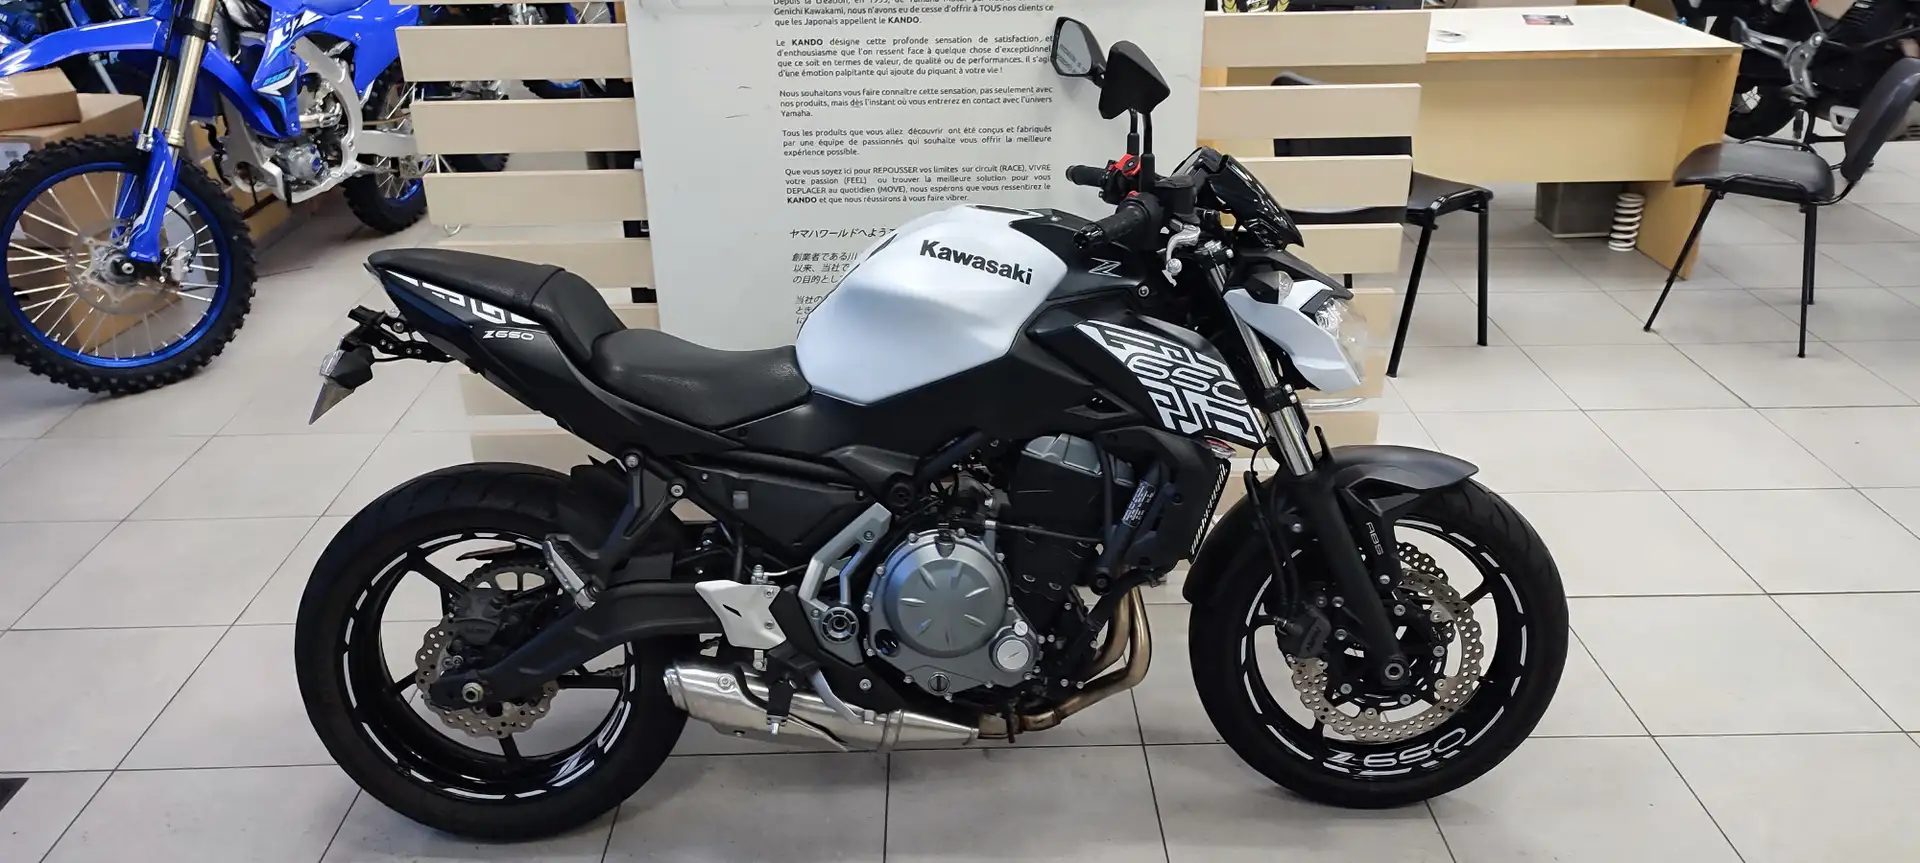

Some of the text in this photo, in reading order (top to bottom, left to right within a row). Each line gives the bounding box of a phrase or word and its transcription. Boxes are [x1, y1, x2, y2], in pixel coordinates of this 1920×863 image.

[773, 7, 803, 15] Genichi
[868, 6, 897, 14] n'avons
[944, 5, 972, 13] d'offrir
[1018, 4, 1044, 12] clients
[804, 17, 838, 27] Japonais
[840, 17, 877, 26] appellent
[792, 38, 823, 46] KANDO
[829, 38, 860, 48] désigne
[866, 37, 886, 45] cette
[892, 36, 929, 46] profonde
[935, 36, 972, 44] sensation
[776, 48, 838, 56] d'enthousiasme
[858, 47, 872, 55] l'on
[876, 47, 904, 55] ressent
[934, 46, 966, 56] quelque
[969, 46, 992, 54] chose
[805, 58, 820, 66] soit
[834, 58, 861, 66] termes
[902, 57, 913, 65] de
[915, 57, 942, 66] qualité
[956, 56, 966, 64] de
[778, 66, 998, 78] d'une émotion palpitante qui ajoute du piquant votre vie
[779, 89, 800, 97] Nous
[800, 88, 842, 97] souhaitons
[862, 88, 880, 96] faire
[918, 87, 939, 95] cette
[980, 88, 993, 96] pas
[994, 86, 1034, 94] seulement
[830, 98, 848, 106] mais
[850, 98, 864, 106] dès
[864, 98, 896, 106] l'instant
[927, 97, 960, 105] entrerez
[972, 96, 1001, 104] contact
[802, 128, 813, 136] les
[815, 128, 848, 138] produits
[886, 127, 903, 135] allez
[948, 126, 961, 134] ont
[963, 126, 976, 134] été
[1016, 125, 1052, 135] fabriqués
[783, 140, 796, 148] par
[818, 138, 844, 148] équipe
[862, 137, 904, 147] passionnés
[908, 137, 920, 146] qui
[924, 136, 956, 144] souhaite
[1016, 135, 1052, 143] meilleure
[784, 148, 825, 158] expérience
[785, 167, 801, 176] Que
[854, 168, 871, 176] pour
[873, 166, 918, 174] REPOUSSER
[934, 165, 958, 173] limites
[974, 164, 998, 172] circuit
[785, 177, 806, 185] votre
[810, 176, 838, 186] passion
[844, 176, 867, 185] (FEEL)
[892, 175, 920, 183] trouver
[936, 174, 971, 182] meilleure
[976, 174, 1006, 182] solution
[1012, 175, 1029, 183] pour
[786, 186, 826, 194] DEPLACER
[840, 185, 876, 195] quotidien
[930, 184, 964, 194] espérons
[1001, 183, 1042, 191] ressentirez
[787, 196, 817, 204] KANDO
[828, 197, 842, 205] que
[864, 194, 901, 202] réussirons
[927, 194, 944, 202] faire
[919, 239, 1034, 286] Kawasaki
[792, 274, 844, 285] の目的とし
[482, 330, 535, 341] Z650
[1366, 521, 1385, 556] ABS
[1326, 727, 1467, 768] Z650
